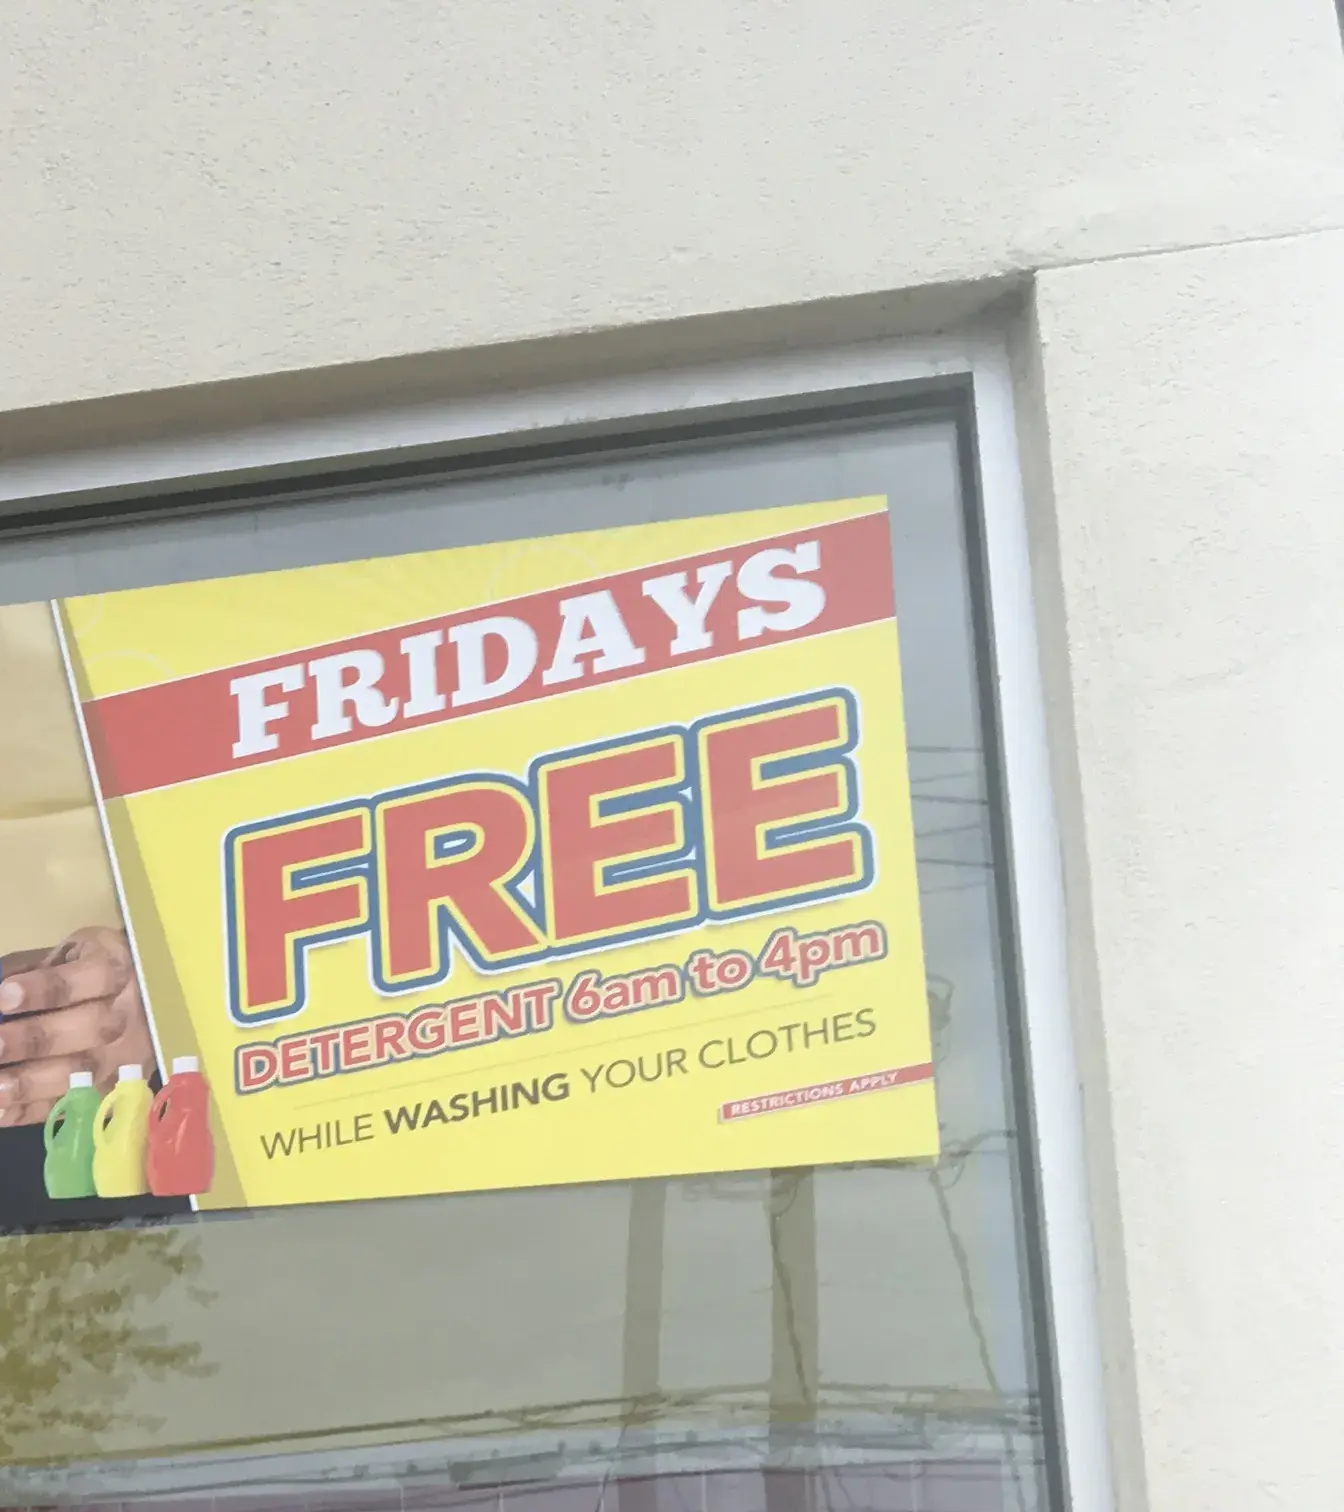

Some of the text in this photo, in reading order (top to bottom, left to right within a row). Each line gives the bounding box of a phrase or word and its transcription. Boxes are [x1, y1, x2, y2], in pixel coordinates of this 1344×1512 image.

[229, 542, 825, 761] FRIDAYS
[223, 688, 875, 1028] FREE
[237, 920, 889, 1096] DETERGENT 6am to 4pm
[260, 1009, 877, 1160] WHILE WASHING YOUR CLOTHES
[731, 1071, 898, 1116] RESTRICTIONS APPLY
